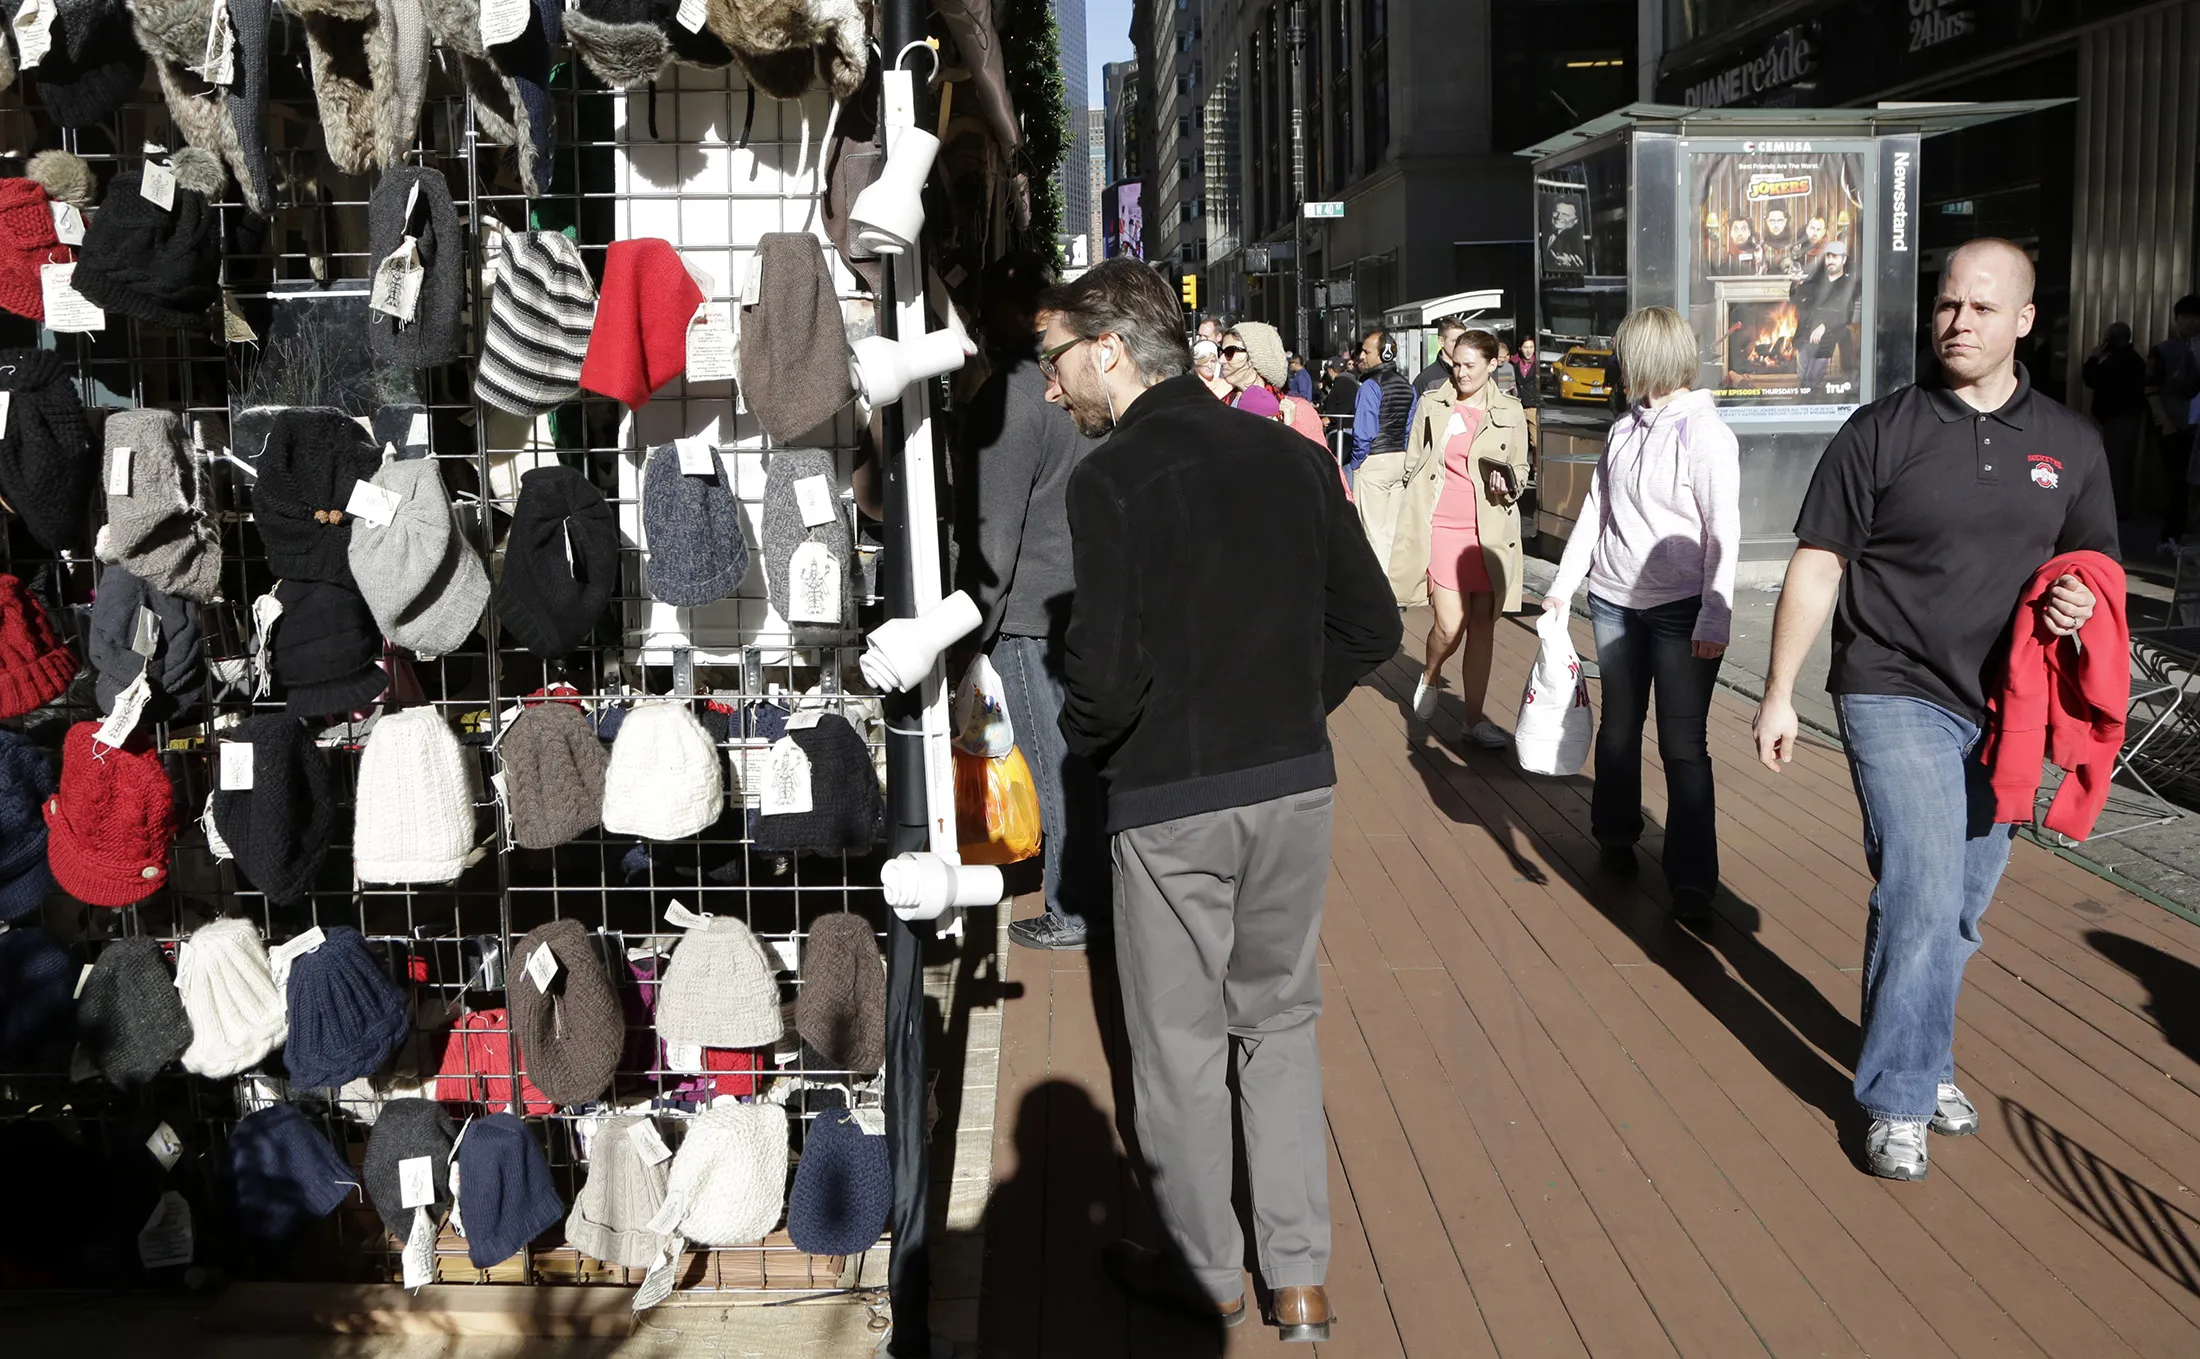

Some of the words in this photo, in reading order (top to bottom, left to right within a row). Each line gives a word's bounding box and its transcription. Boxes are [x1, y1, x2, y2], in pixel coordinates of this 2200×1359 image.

[1908, 10, 1967, 53] 24hrs
[1685, 65, 1742, 107] DUANE
[1742, 26, 1811, 94] reade
[1758, 142, 1812, 152] CEMUSA
[1750, 179, 1810, 198] JOKERS
[1893, 152, 1910, 252] Newsstand
[1324, 204, 1334, 215] 40
